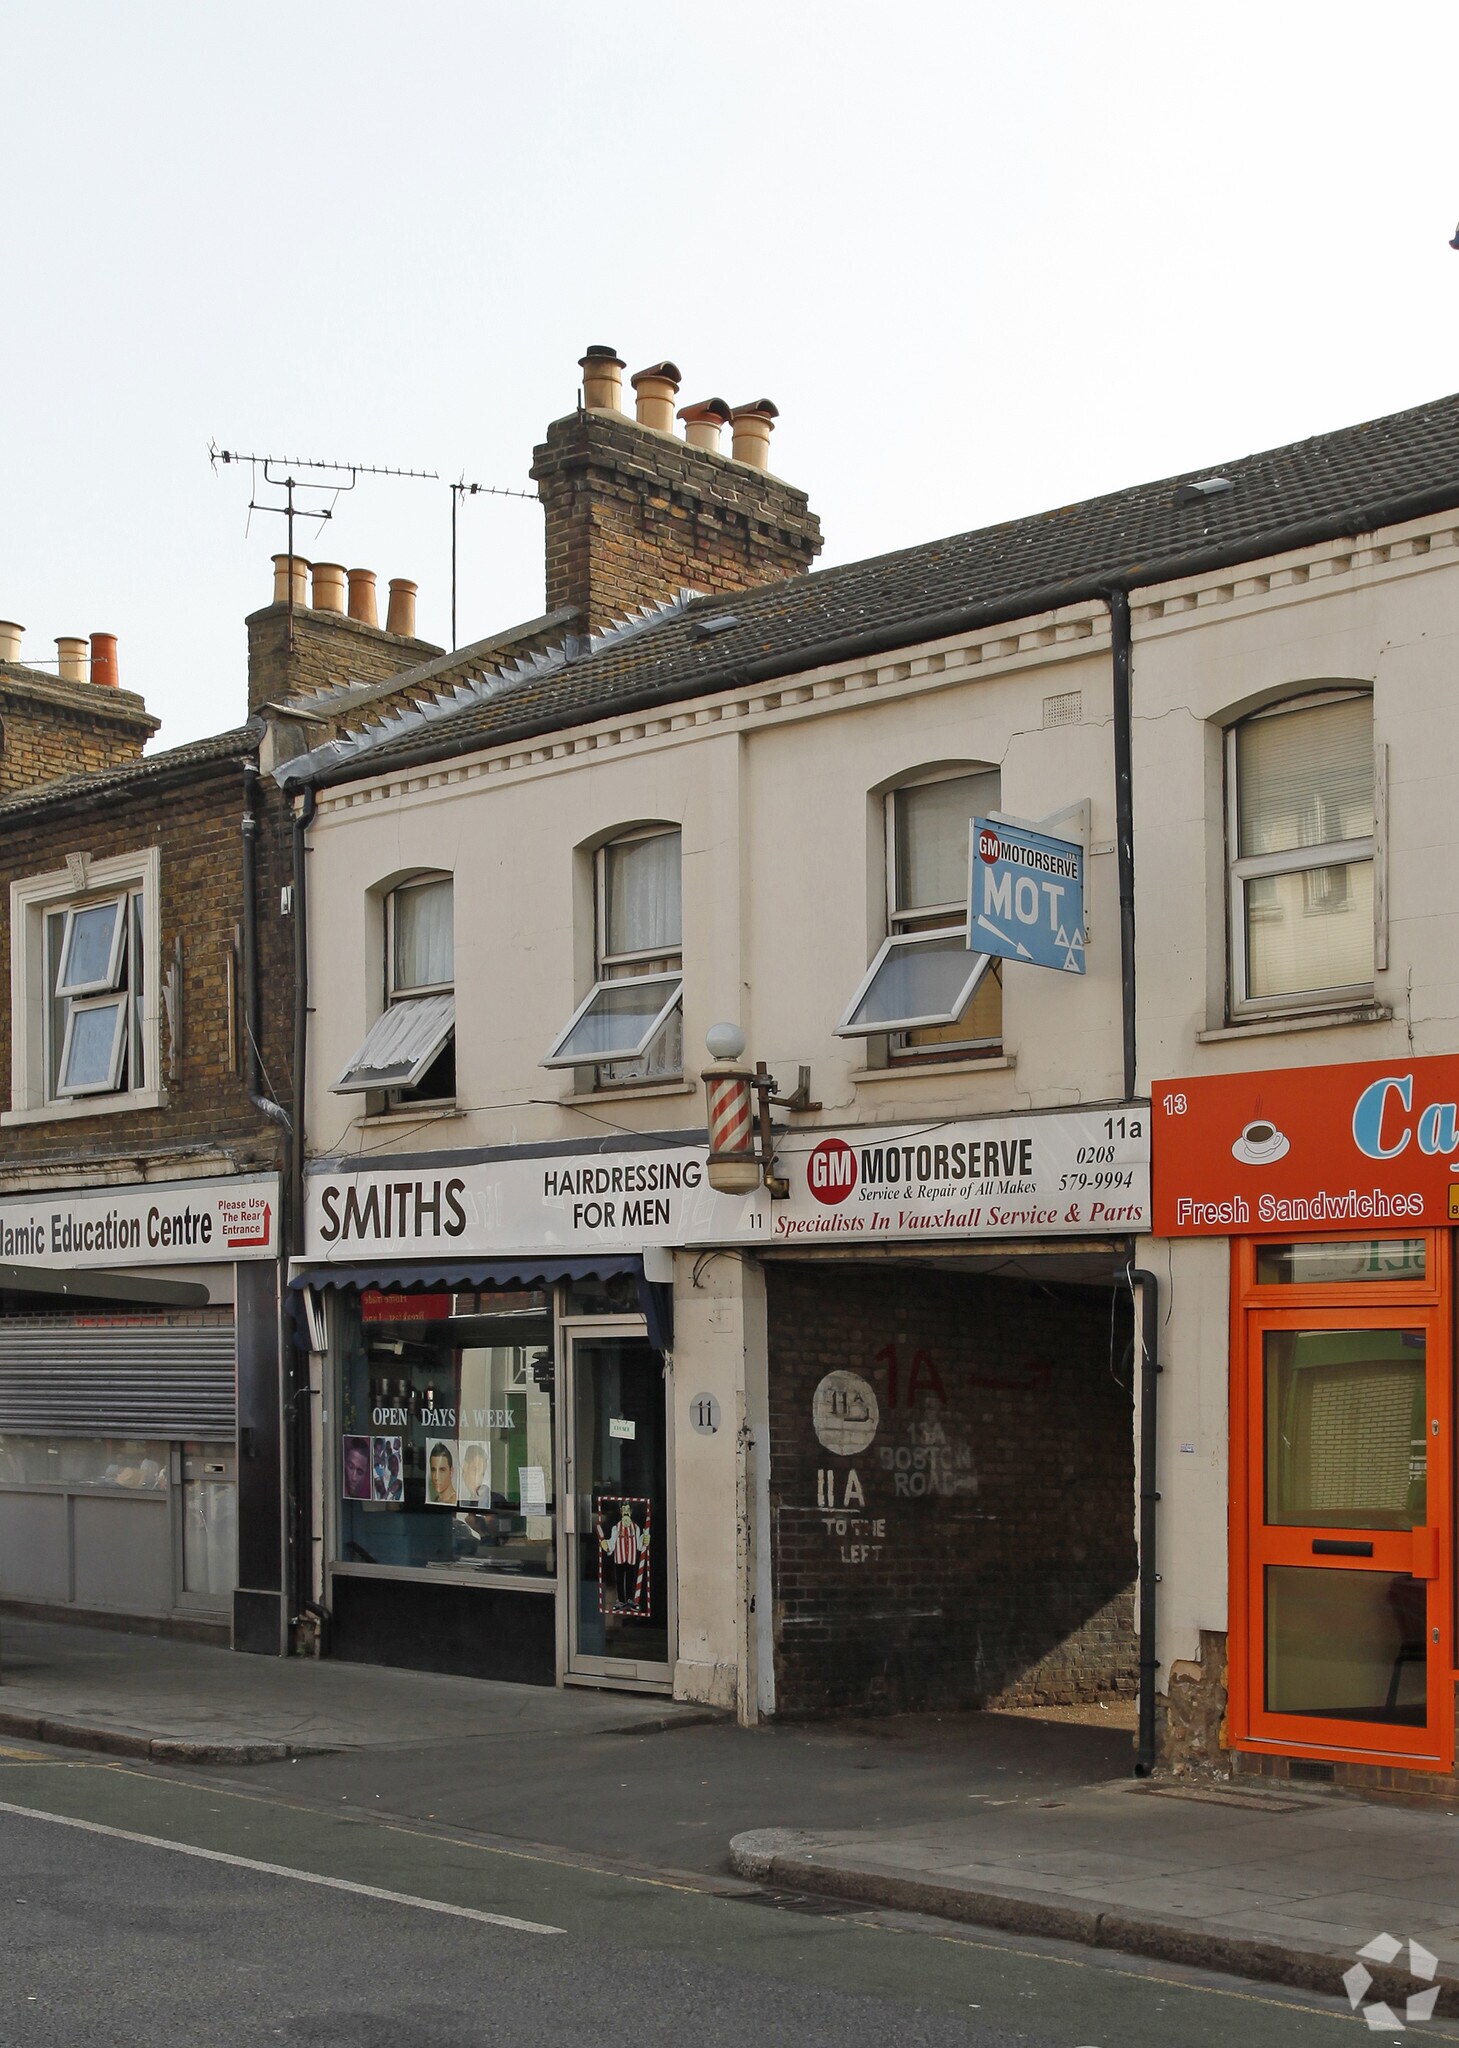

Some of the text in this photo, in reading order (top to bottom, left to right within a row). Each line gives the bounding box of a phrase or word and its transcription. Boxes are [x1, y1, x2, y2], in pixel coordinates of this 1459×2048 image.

[979, 835, 1078, 880] GM MOTORSERVE
[984, 866, 1065, 931] MOT
[1163, 1094, 1187, 1115] 13
[1103, 1116, 1142, 1140] 11a
[812, 1139, 1032, 1188] GM MOTORSERVE
[1076, 1145, 1115, 1165] 0208
[544, 1161, 702, 1197] HAIRDRESSING
[859, 1179, 1037, 1202] Service & Repair of All Makes
[1059, 1171, 1133, 1192] 579-9994
[218, 1198, 265, 1210] Please Use
[319, 1178, 467, 1242] SMITHS
[573, 1199, 670, 1229] FOR MEN
[1177, 1189, 1424, 1225] Fresh Sandwiches
[222, 1211, 261, 1222] The Rear
[750, 1213, 763, 1229] 11
[775, 1202, 1143, 1238] Specialists In Vauxhall Service & Parts
[51, 1210, 140, 1253] Education
[147, 1204, 212, 1248] Centre
[222, 1224, 261, 1235] Entrance
[372, 1407, 516, 1429] OPEN DAYS A WEEK
[697, 1400, 713, 1427] 11
[821, 1518, 847, 1536] TO
[840, 1545, 883, 1564] LEFT
